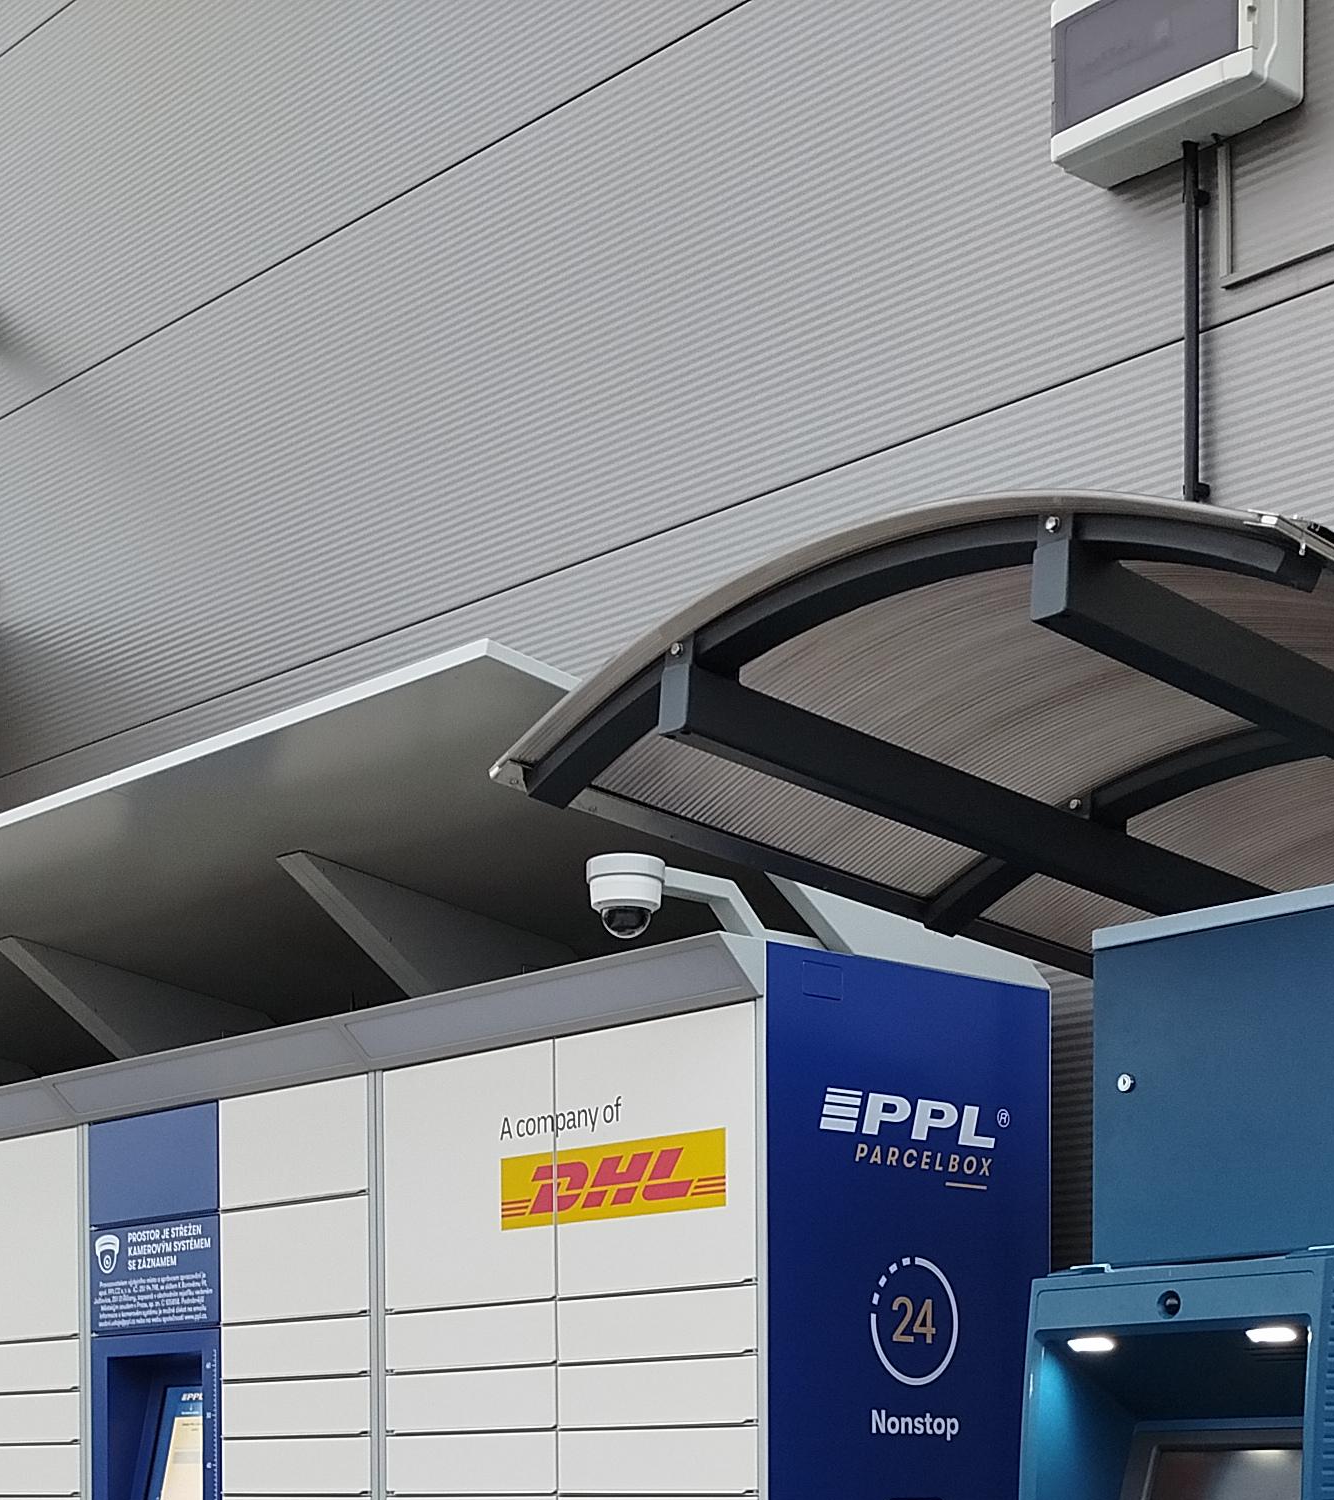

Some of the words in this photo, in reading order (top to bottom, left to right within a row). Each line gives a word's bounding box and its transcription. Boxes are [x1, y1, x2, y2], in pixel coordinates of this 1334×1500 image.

[500, 1117, 512, 1140] A
[516, 1105, 598, 1138] company
[603, 1095, 622, 1124] of
[855, 1143, 993, 1177] PARCELBOX
[529, 1147, 694, 1215] DHL
[127, 1229, 161, 1244] PROSTOR
[161, 1227, 170, 1240] JE
[170, 1223, 202, 1239] STŘEŽEN
[127, 1241, 172, 1257] KAMEROVÝM
[173, 1237, 211, 1252] SYSTÉMEM
[127, 1259, 137, 1271] SE
[137, 1255, 177, 1270] ZÁZNAMEM
[892, 1296, 936, 1344] 24
[871, 1409, 959, 1441] Nonstop
